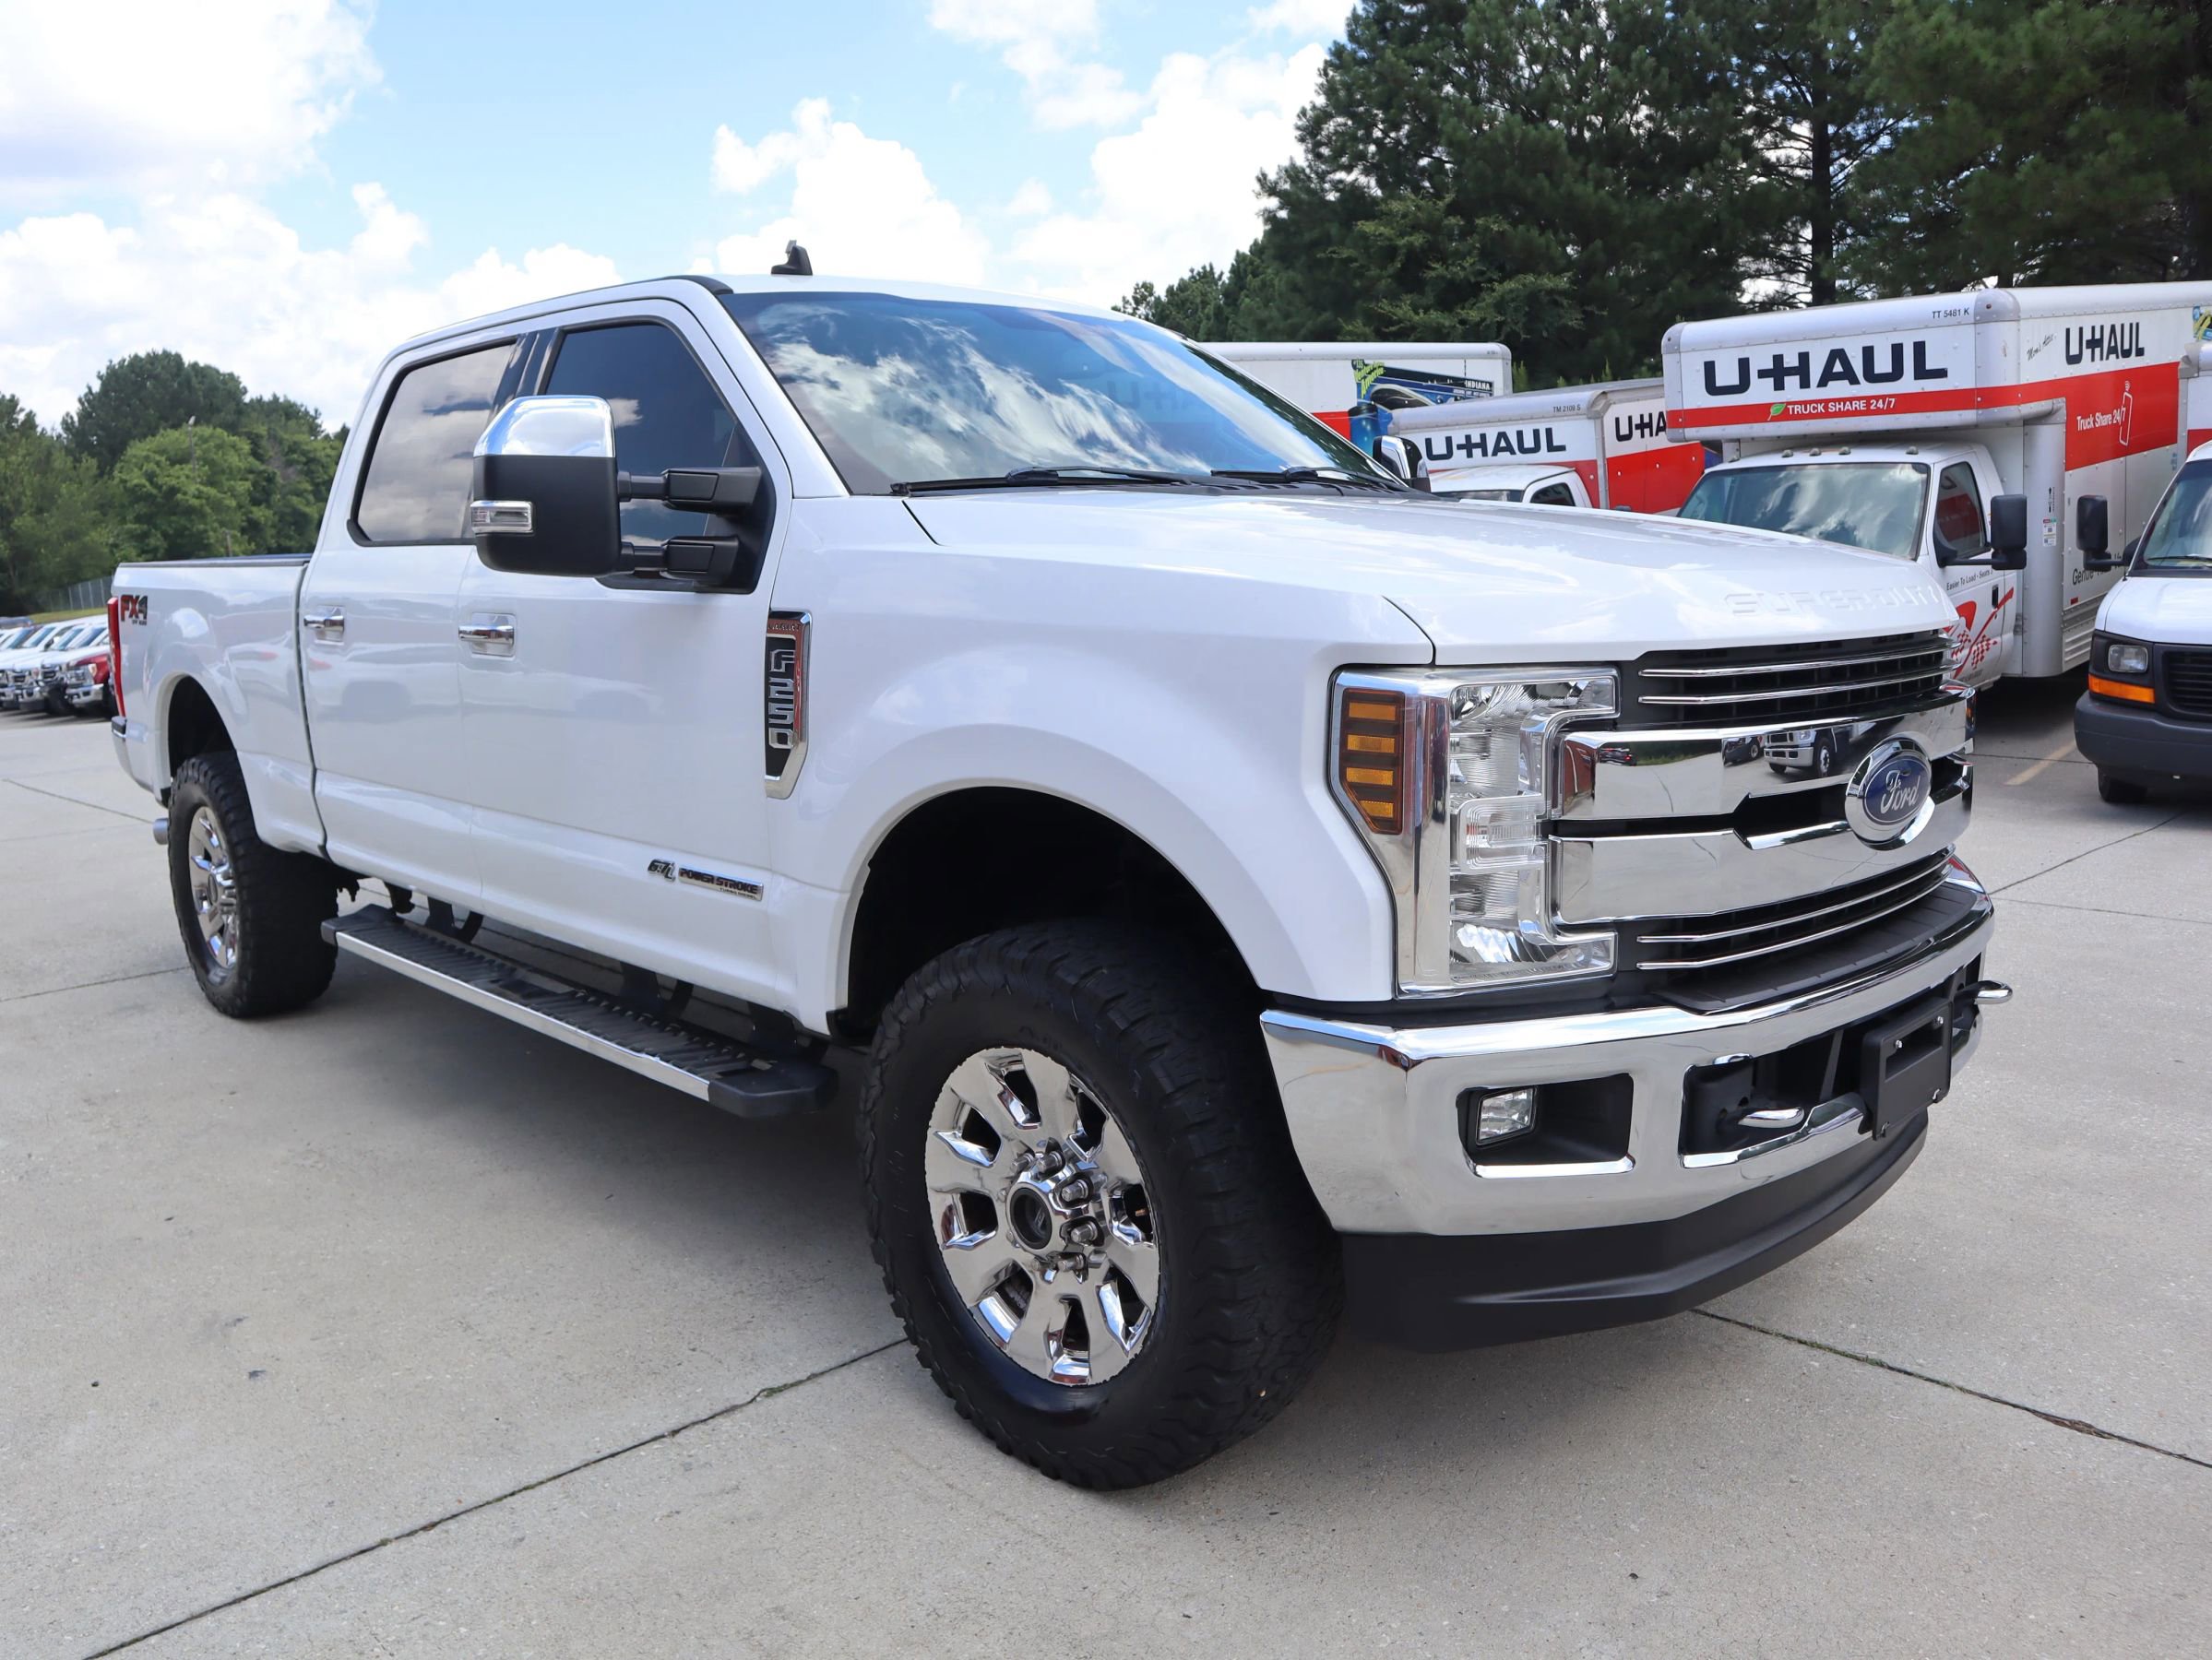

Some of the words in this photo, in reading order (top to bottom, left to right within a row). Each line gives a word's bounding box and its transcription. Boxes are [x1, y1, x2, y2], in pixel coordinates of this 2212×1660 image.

[1932, 311, 1942, 319] TT
[1944, 309, 1962, 318] 5481
[1963, 307, 1970, 316] K
[2065, 322, 2145, 365] U-HAUL
[1704, 340, 1948, 397] U-HAUL
[1465, 379, 1491, 391] INDIANA
[1552, 406, 1562, 414] TM
[1787, 403, 1825, 415] TRUCK
[1828, 400, 1867, 412] SHARE
[1870, 397, 1896, 410] 24/7
[2076, 414, 2094, 432] Truck
[2095, 411, 2111, 428] Share
[2112, 405, 2126, 425] 24/7
[1615, 411, 1667, 442] U-HA
[1425, 427, 1566, 461] U-HAUL
[1946, 581, 1960, 591] Easier
[1960, 576, 1966, 586] To
[1966, 573, 1977, 584] Load
[121, 594, 148, 622] FX4
[768, 649, 795, 749] F250
[1881, 769, 1921, 814] Ford
[679, 867, 714, 886] POWER
[715, 876, 757, 895] STROKE
